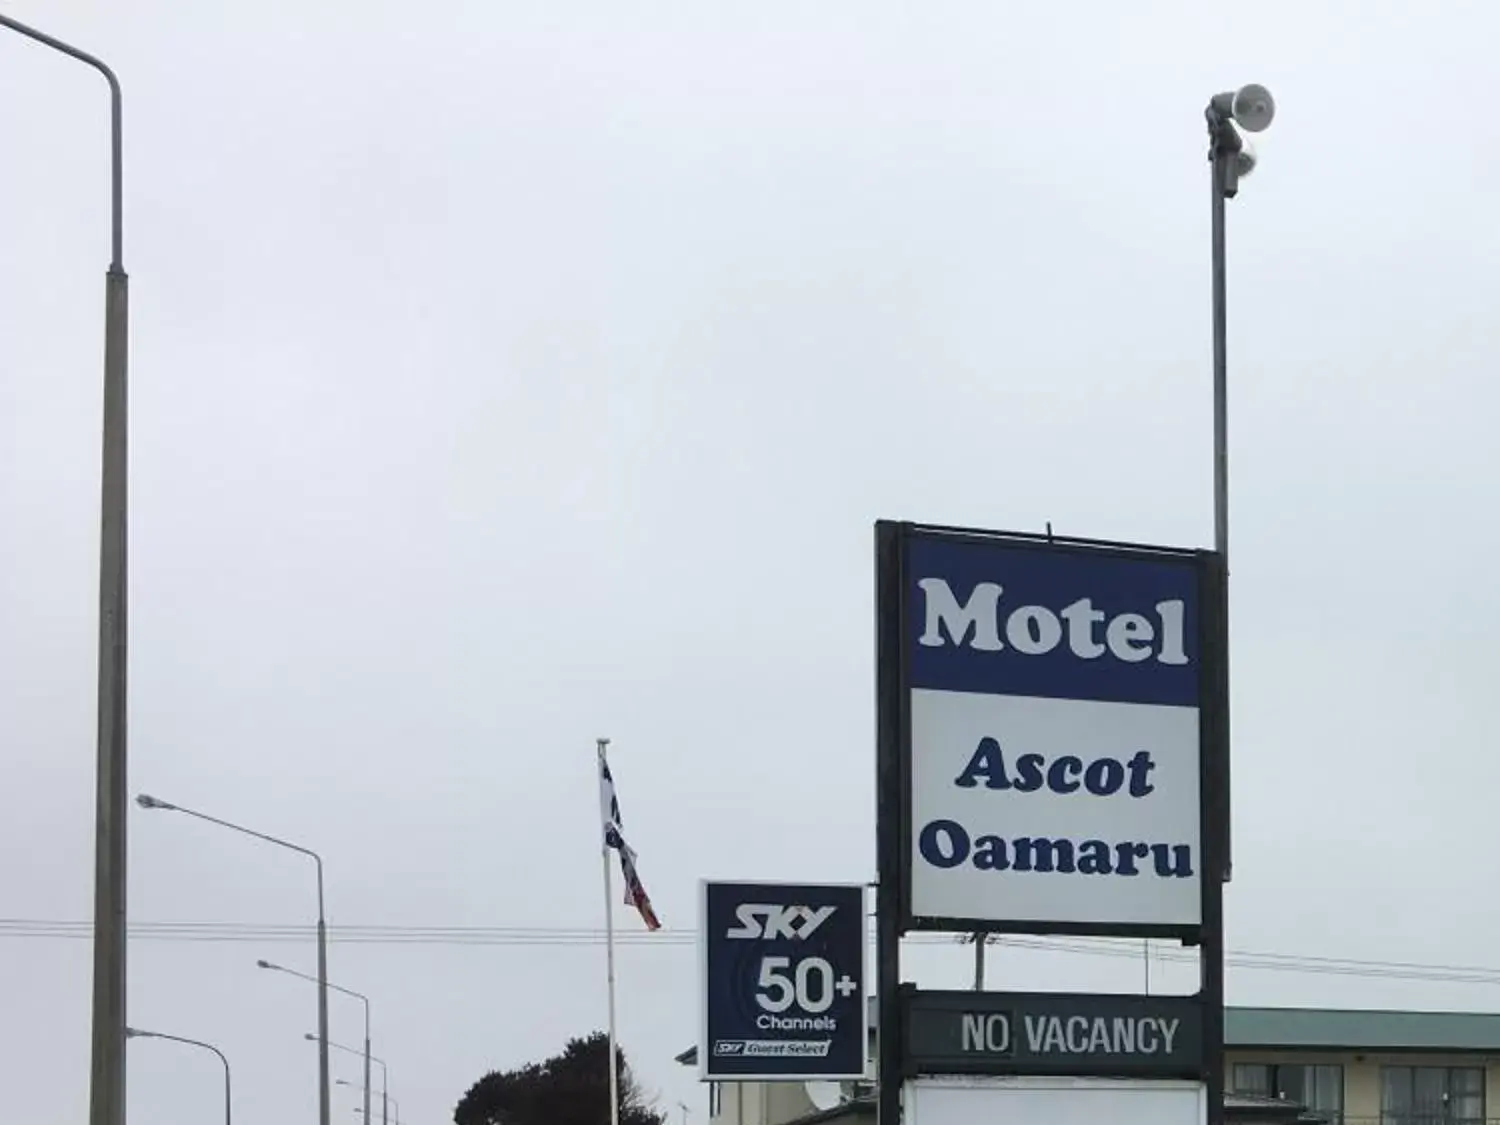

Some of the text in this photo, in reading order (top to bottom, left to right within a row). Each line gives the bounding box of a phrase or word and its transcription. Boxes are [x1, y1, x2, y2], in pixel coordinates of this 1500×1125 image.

[917, 576, 1189, 665] Motel
[954, 736, 1156, 798] Ascot
[918, 819, 1194, 878] Oamaru
[725, 903, 838, 940] SKY
[755, 956, 857, 1013] 50+
[756, 1015, 836, 1030] Channels
[962, 1013, 1180, 1054] NO VACANCY
